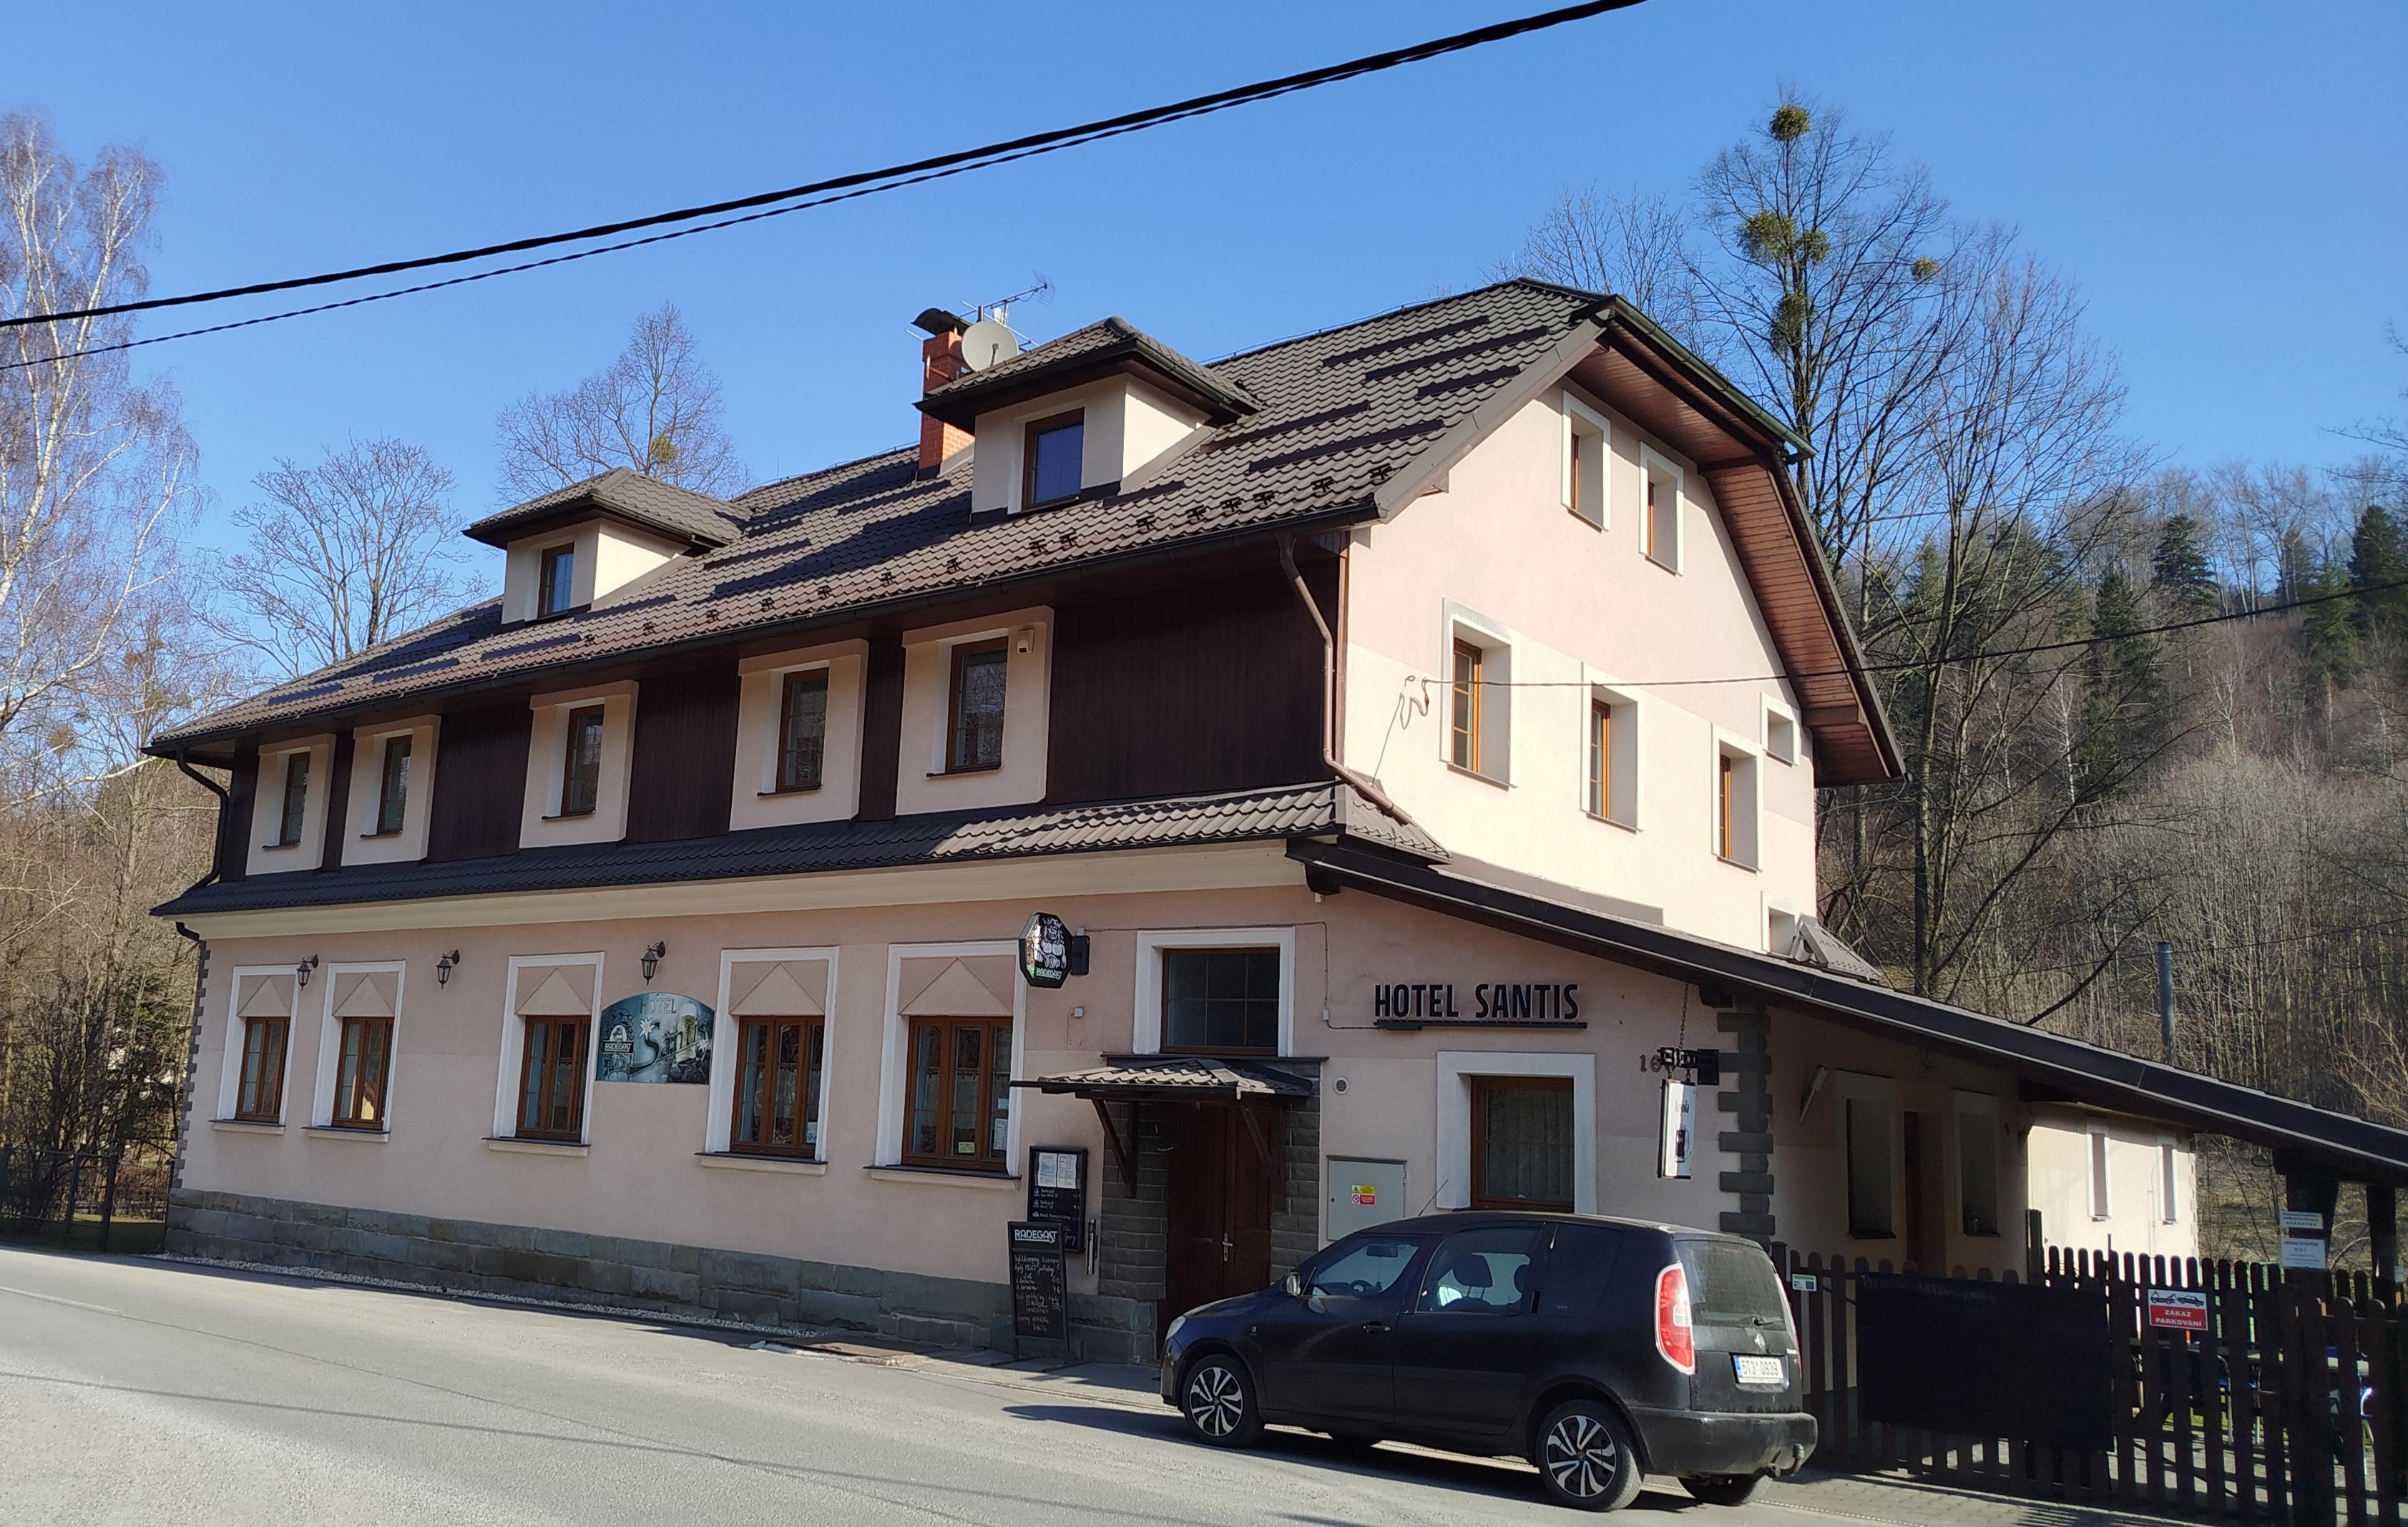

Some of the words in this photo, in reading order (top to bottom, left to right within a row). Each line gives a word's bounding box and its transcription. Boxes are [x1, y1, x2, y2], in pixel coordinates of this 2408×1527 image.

[640, 997, 677, 1014] HOTEL
[1375, 984, 1459, 1018] HOTEL
[1475, 984, 1579, 1019] SANTIS
[605, 1042, 632, 1053] RADEGAST
[1014, 1229, 1057, 1244] RADEGAST
[2155, 1317, 2202, 1327] PARKOVÁNÍ
[1741, 1360, 1756, 1375] 5T3
[1760, 1360, 1778, 1376] 0939
